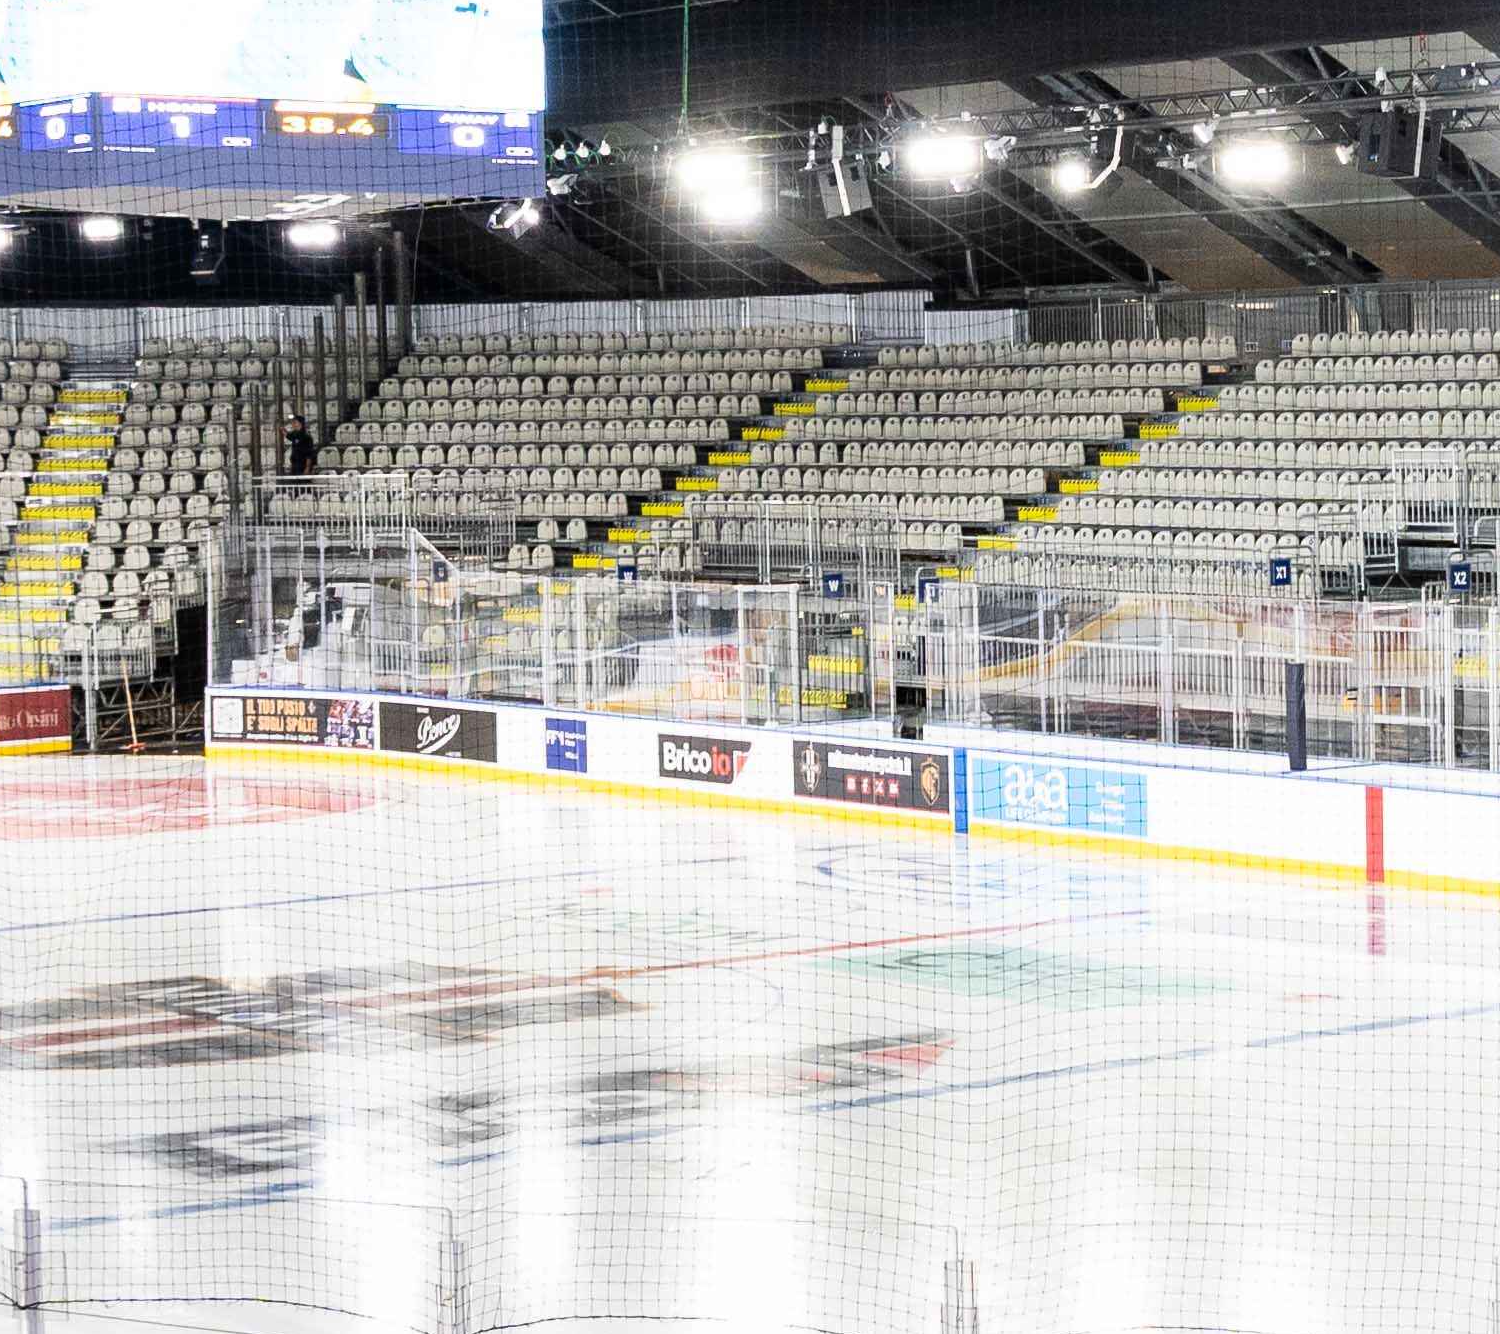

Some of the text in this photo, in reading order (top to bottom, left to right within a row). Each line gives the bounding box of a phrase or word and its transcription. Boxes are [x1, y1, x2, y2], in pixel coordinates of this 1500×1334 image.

[1275, 565, 1287, 579] X1
[1453, 571, 1467, 585] X2
[828, 579, 839, 592] W
